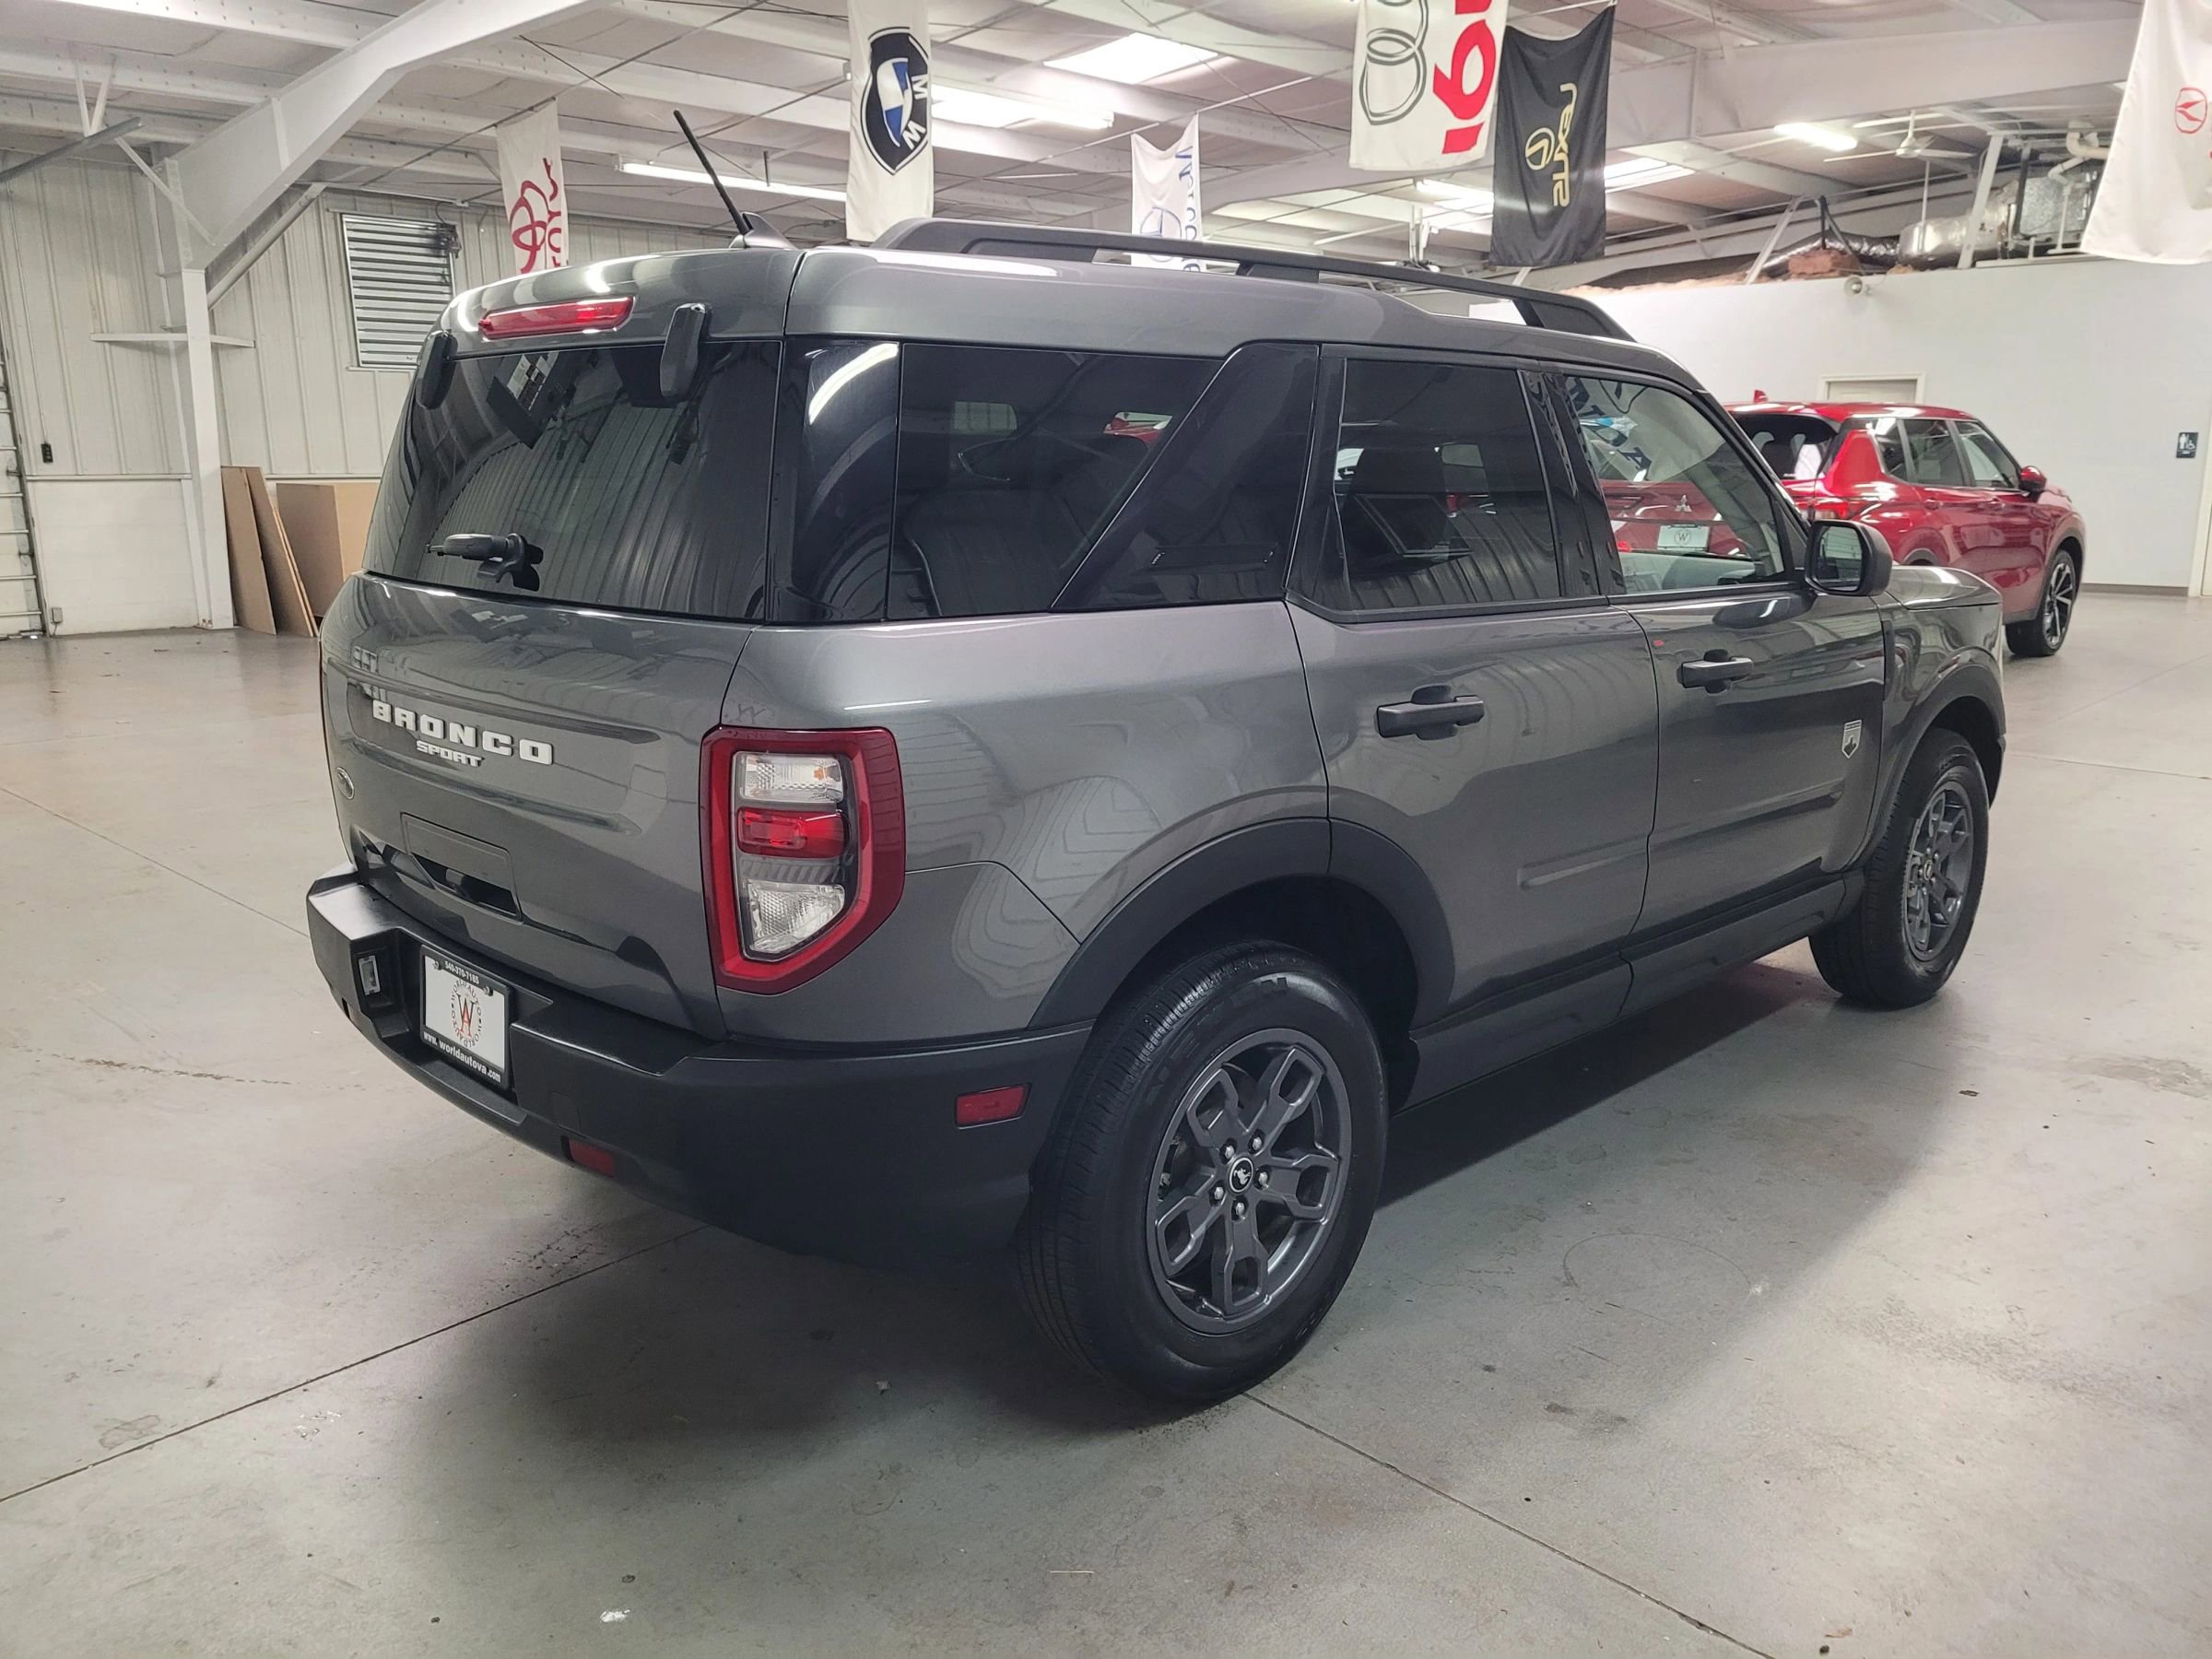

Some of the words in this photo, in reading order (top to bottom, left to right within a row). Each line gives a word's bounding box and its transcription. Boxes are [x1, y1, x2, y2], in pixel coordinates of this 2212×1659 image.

[902, 74, 927, 150] MW
[372, 699, 553, 766] BRONCO
[416, 740, 484, 767] SPORT
